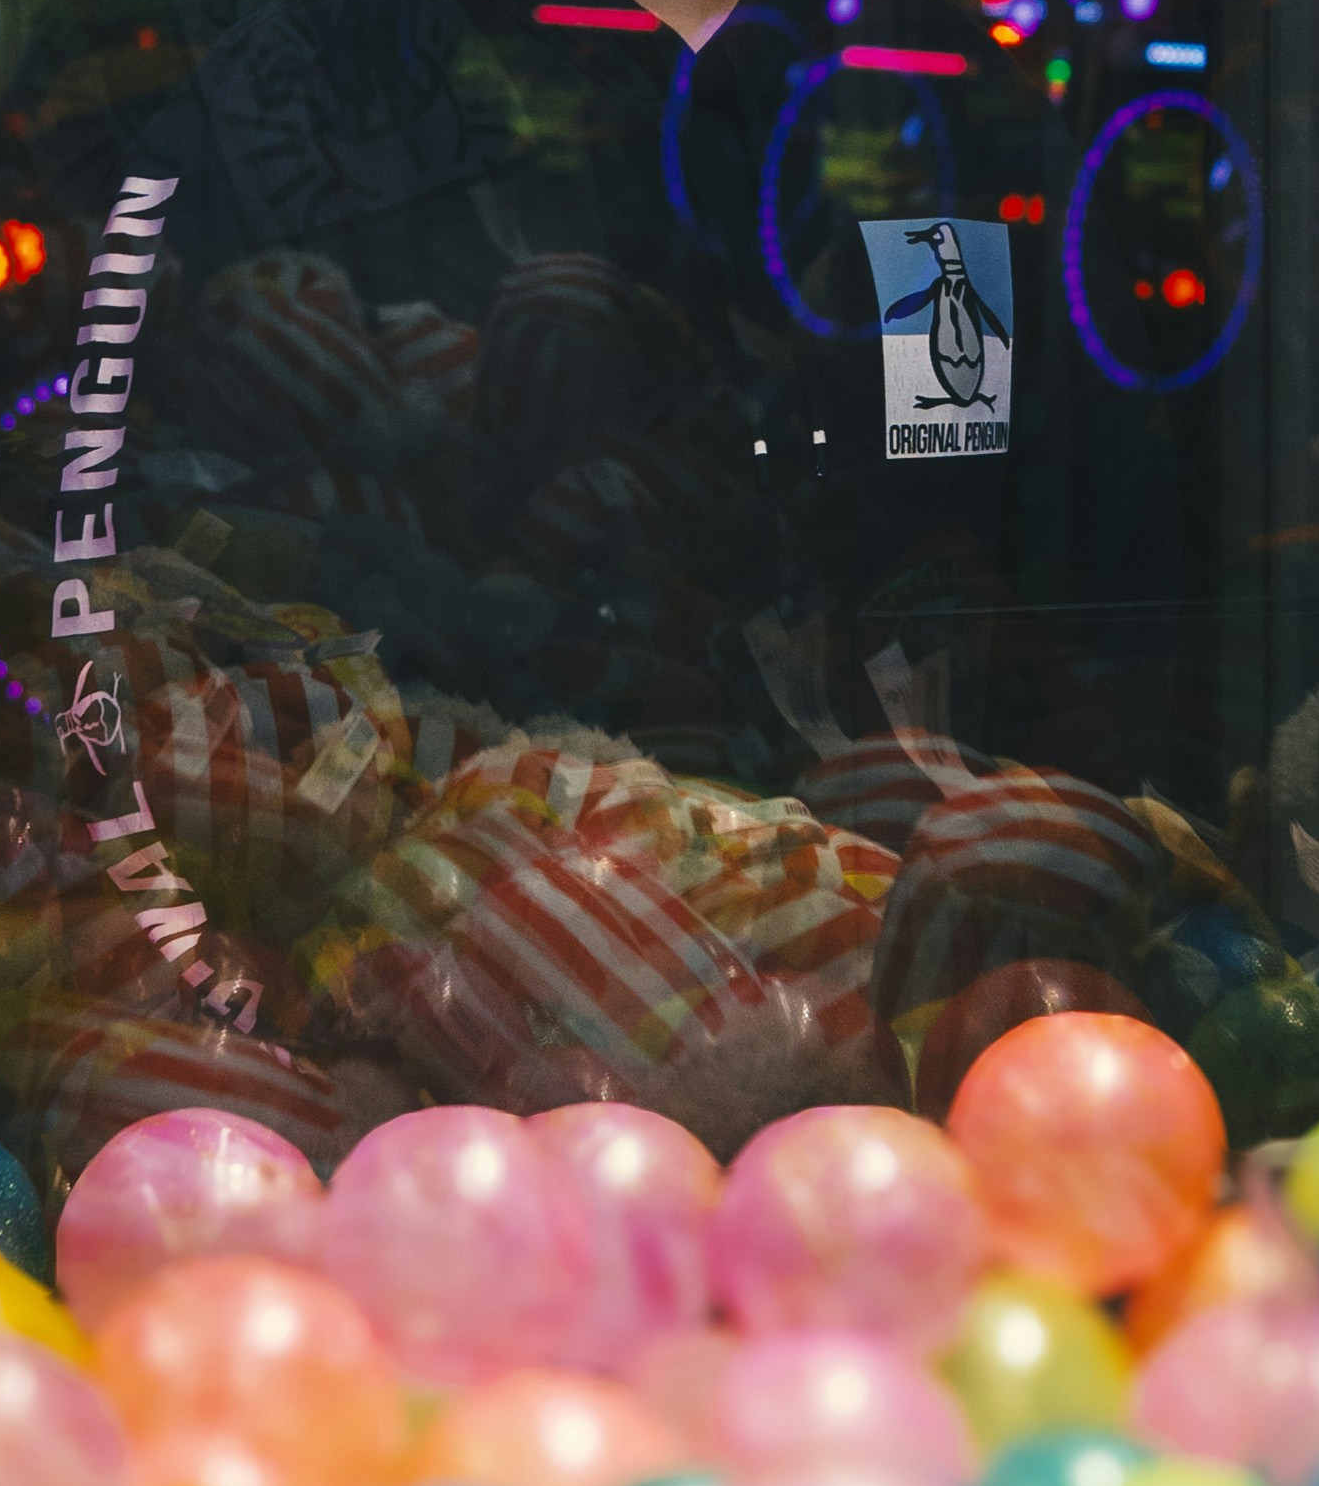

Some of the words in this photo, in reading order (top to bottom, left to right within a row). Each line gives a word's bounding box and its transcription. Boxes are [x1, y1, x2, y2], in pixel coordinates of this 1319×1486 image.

[51, 176, 179, 638] PENGUIN
[889, 423, 961, 454] ORIGINAL
[965, 422, 1007, 452] PENGUIN
